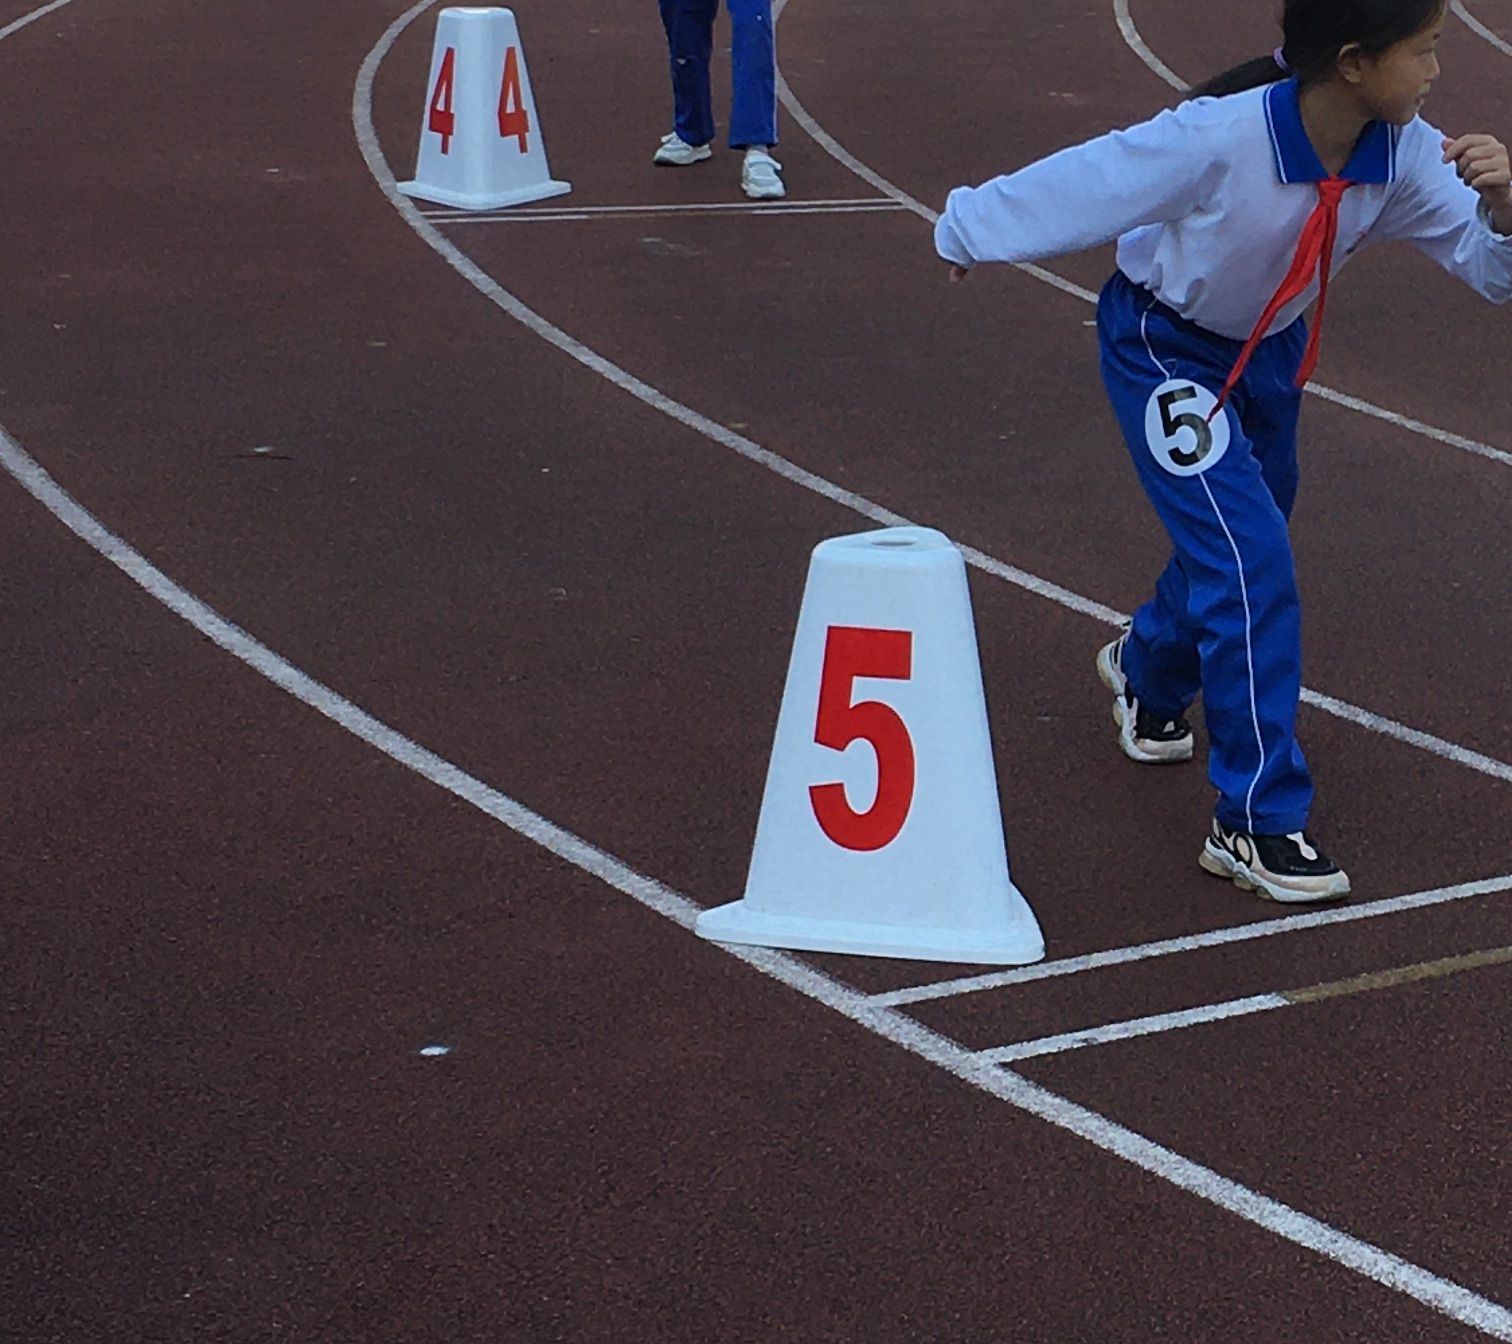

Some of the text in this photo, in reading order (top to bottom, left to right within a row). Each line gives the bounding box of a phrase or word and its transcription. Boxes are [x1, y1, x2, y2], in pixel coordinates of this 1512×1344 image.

[429, 47, 455, 154] 4
[497, 47, 529, 154] 4
[1156, 385, 1213, 467] 5
[808, 625, 916, 852] 5
